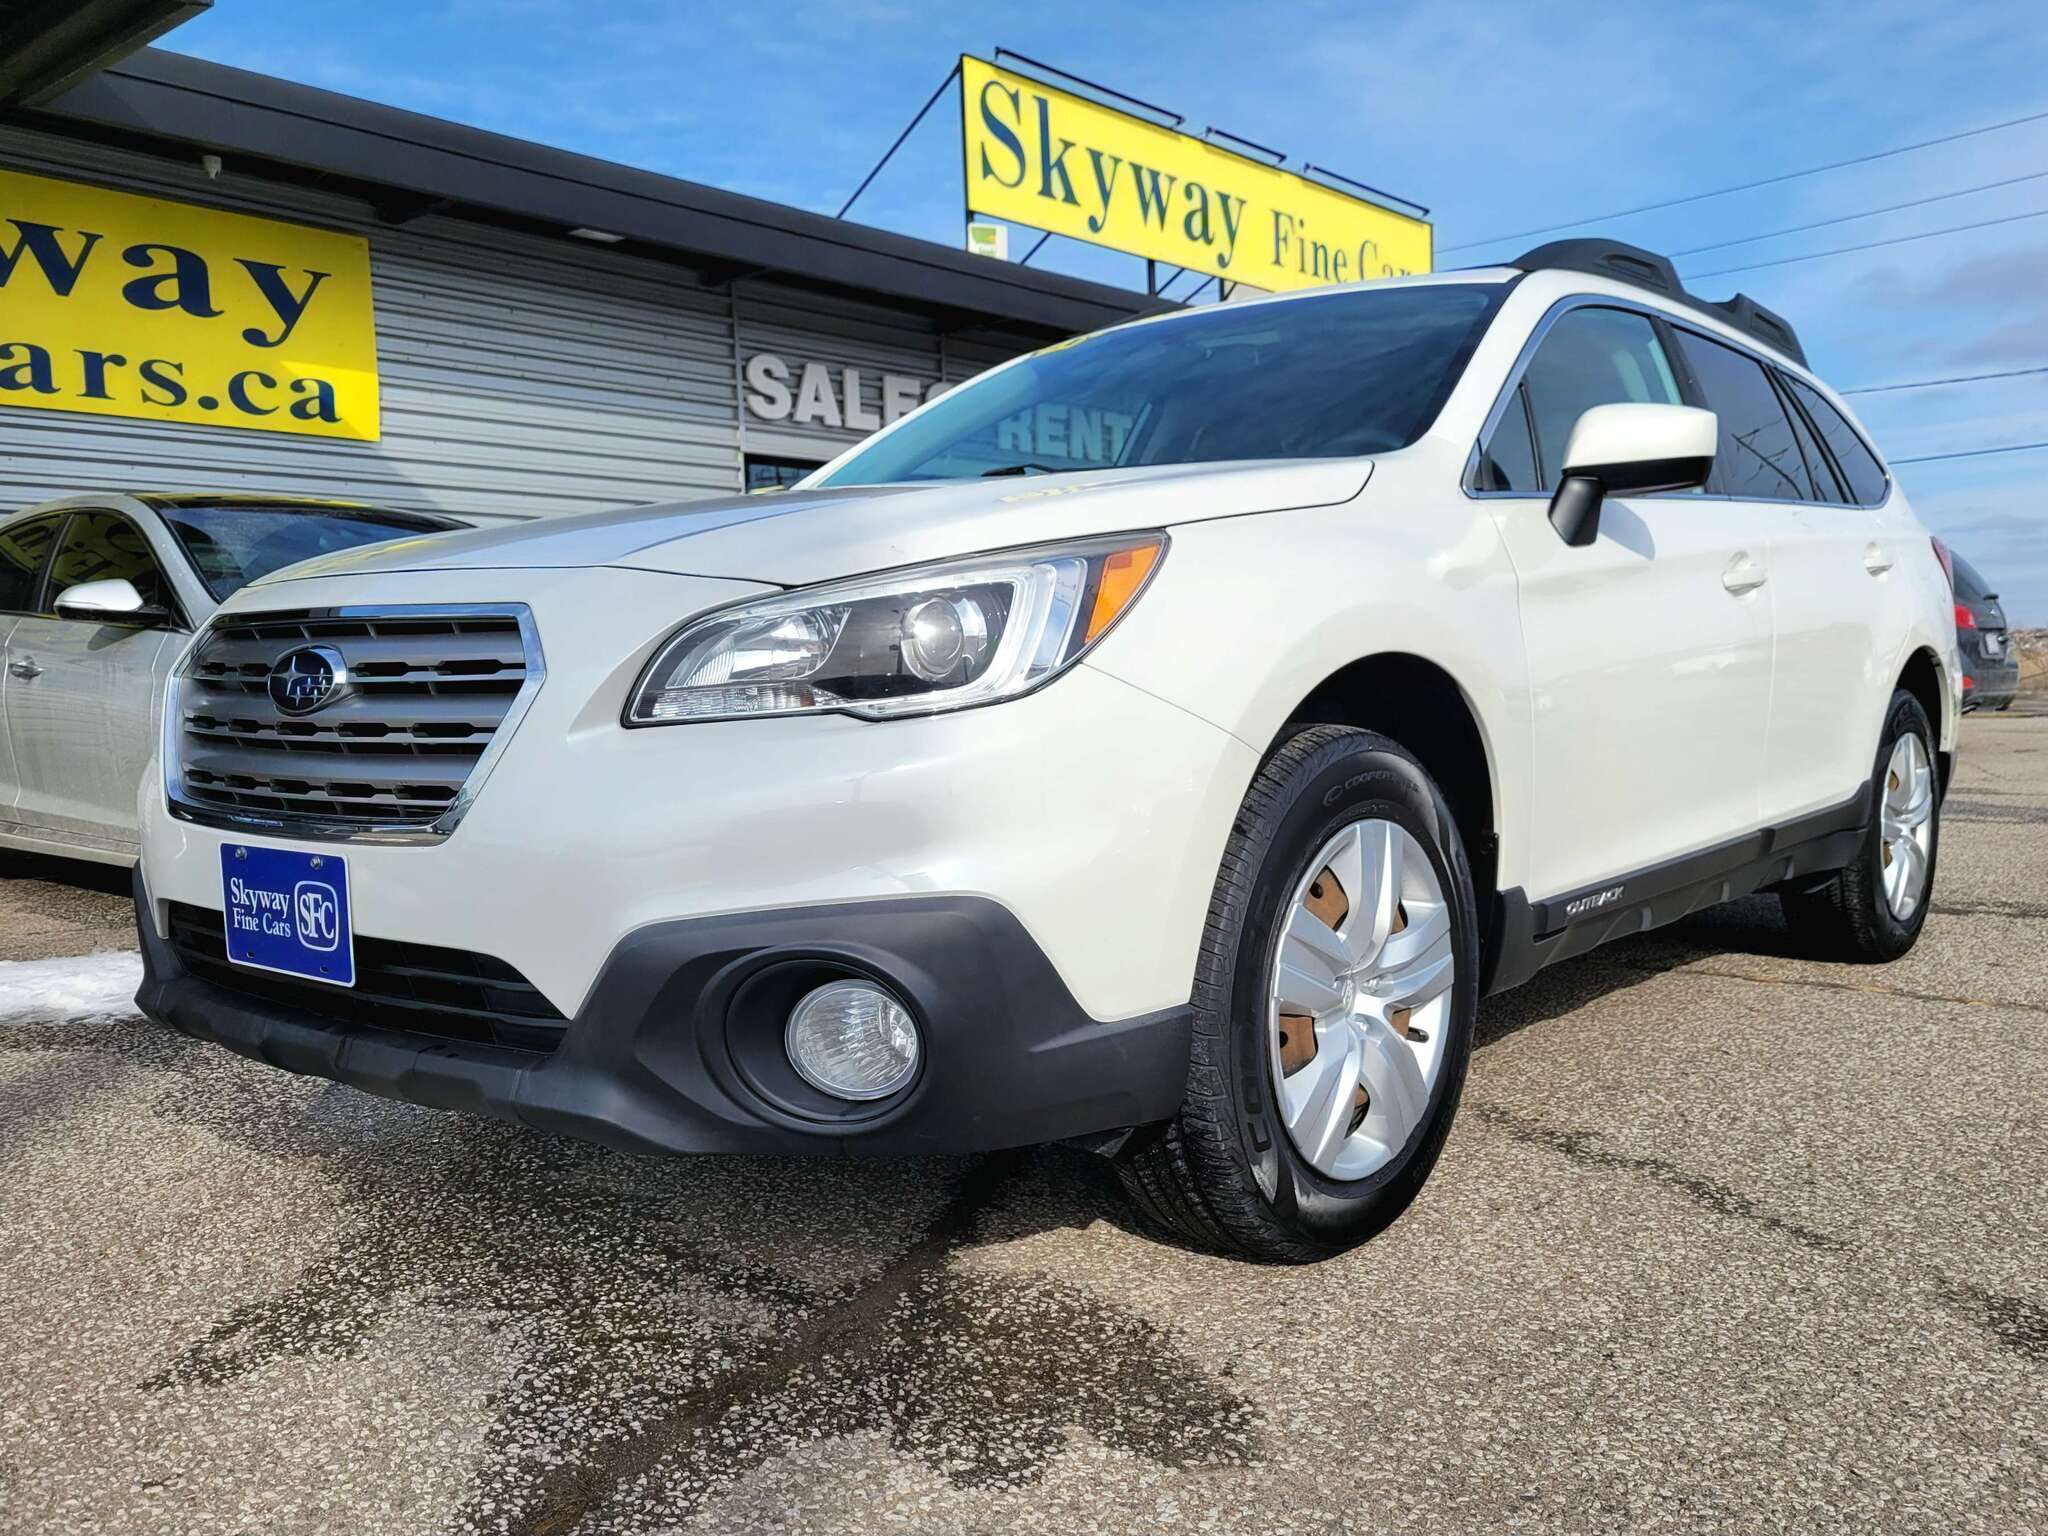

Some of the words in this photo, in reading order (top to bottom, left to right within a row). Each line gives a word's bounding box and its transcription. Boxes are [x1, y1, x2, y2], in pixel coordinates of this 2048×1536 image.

[979, 79, 1247, 270] Skyway
[1270, 208, 1348, 284] Fine
[746, 352, 959, 431] SALE
[230, 877, 290, 919] Skyway
[300, 892, 335, 939] SFC
[1566, 886, 1625, 916] OUTBACK
[232, 907, 260, 932] Fine
[262, 912, 291, 938] Cars
